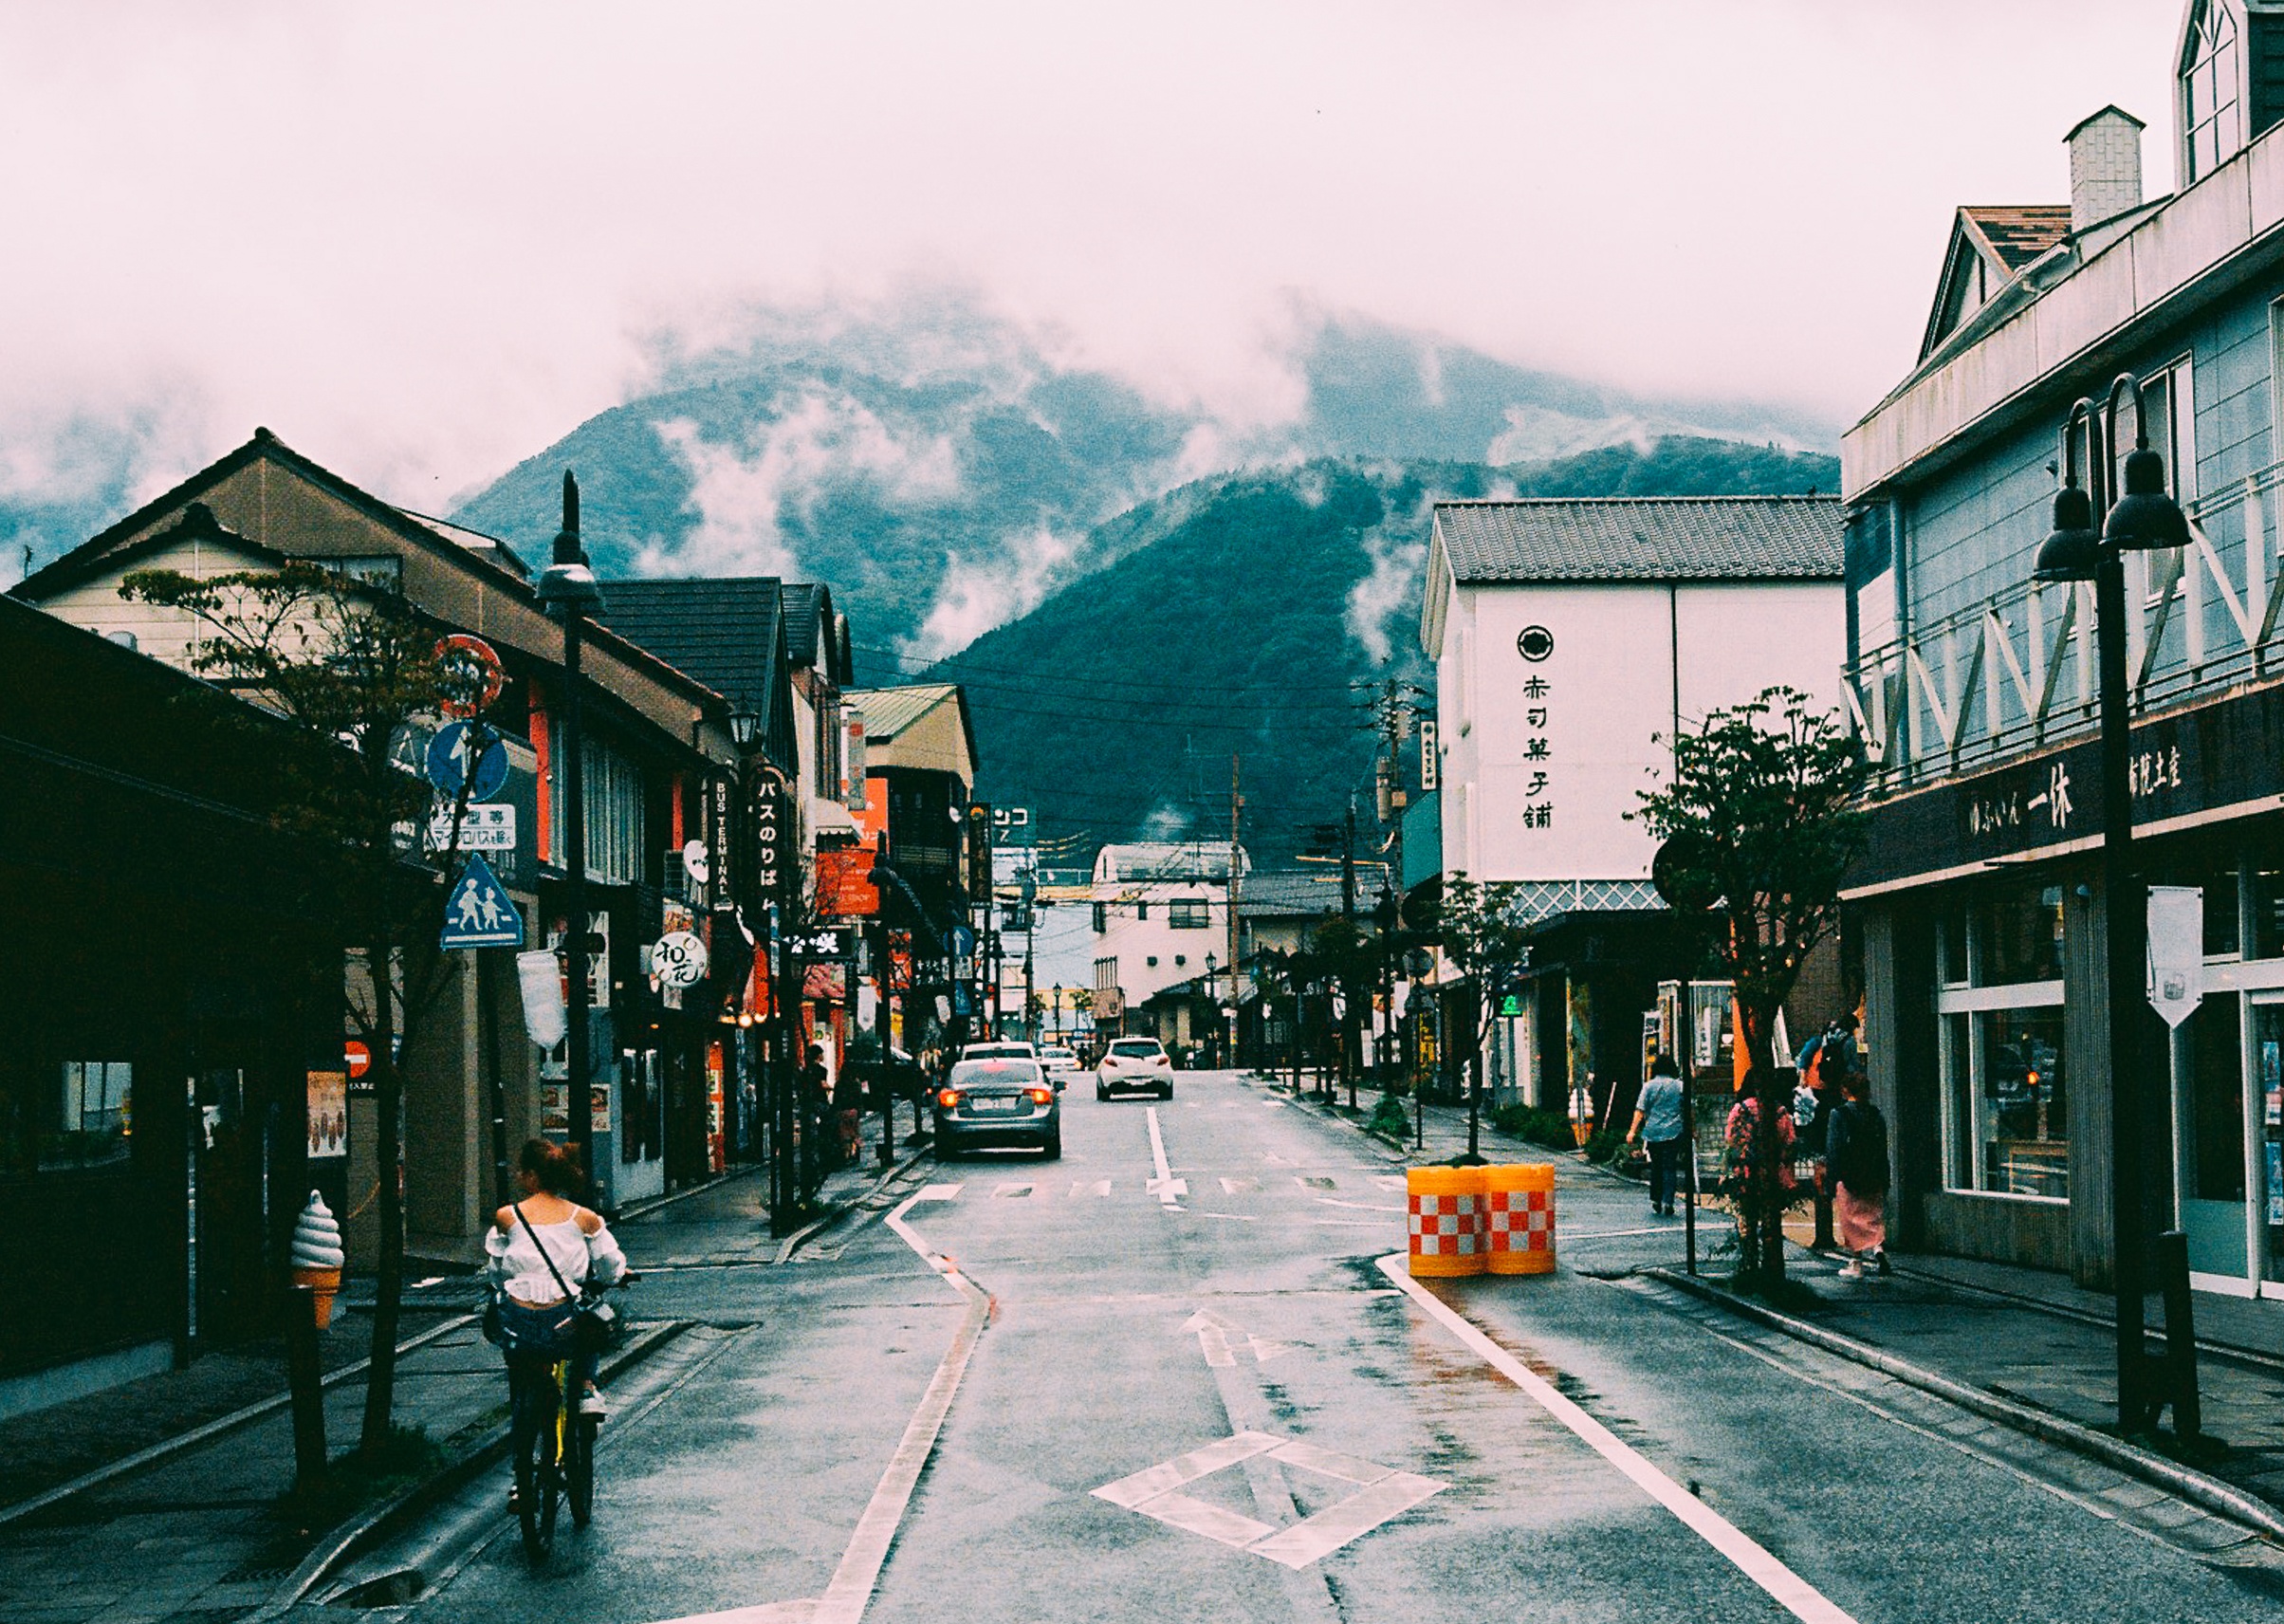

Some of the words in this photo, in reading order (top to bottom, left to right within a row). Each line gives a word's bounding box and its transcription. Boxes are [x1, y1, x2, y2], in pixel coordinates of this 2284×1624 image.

[716, 782, 727, 813] BUS
[2028, 762, 2073, 829] 一休
[717, 816, 728, 895] TERMINAL
[759, 783, 777, 886] バスのりば
